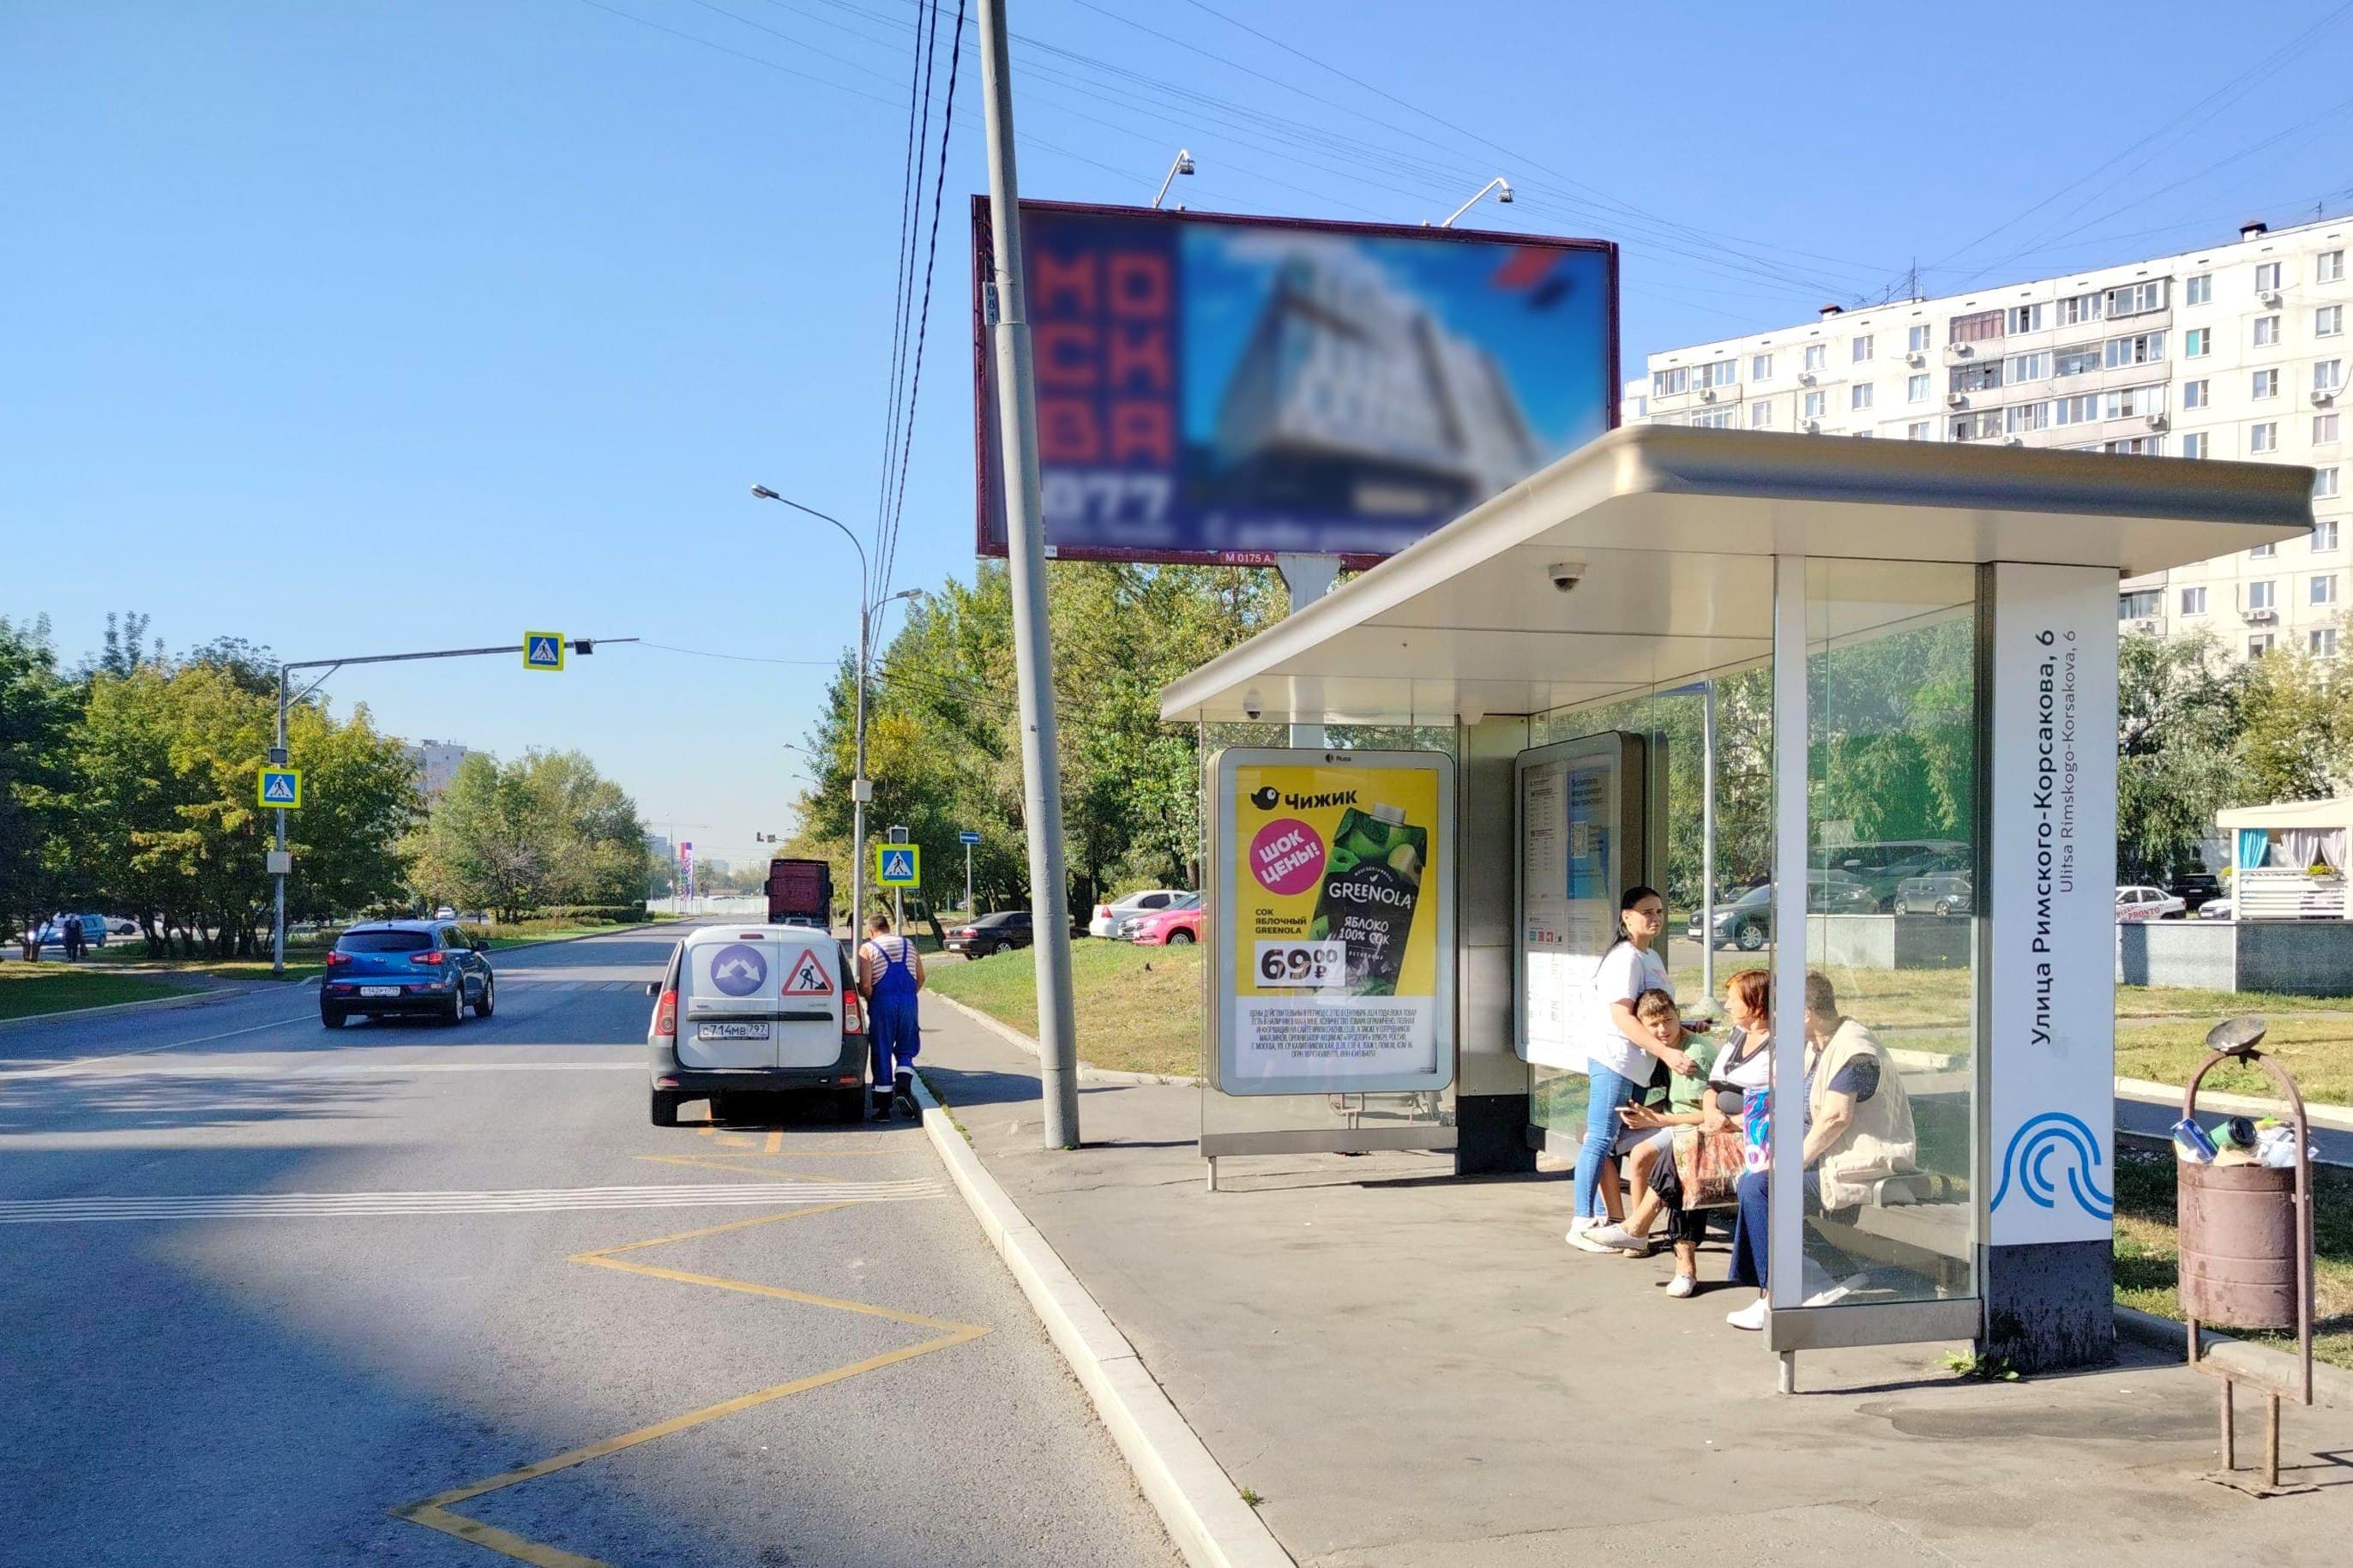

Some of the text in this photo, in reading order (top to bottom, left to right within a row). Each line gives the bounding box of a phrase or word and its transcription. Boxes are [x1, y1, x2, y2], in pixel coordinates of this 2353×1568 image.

[1237, 553, 1261, 564] 0175
[2060, 630, 2078, 892] Ulitsa Rimskogo-Korsakova, 6
[1259, 828, 1305, 863] ШОК
[2031, 630, 2057, 1045] Улица Римского-Корсакова, 6
[1261, 841, 1321, 885] ЦЕНЫ!
[1328, 881, 1411, 910] GREENOLA
[1255, 916, 1307, 925] ЯБЛОЧНЫЙ
[1344, 916, 1389, 933] ЯБЛОКО
[2128, 906, 2160, 920] PRONTO
[1339, 927, 1391, 945] 100% СОК
[1261, 948, 1312, 981] 69
